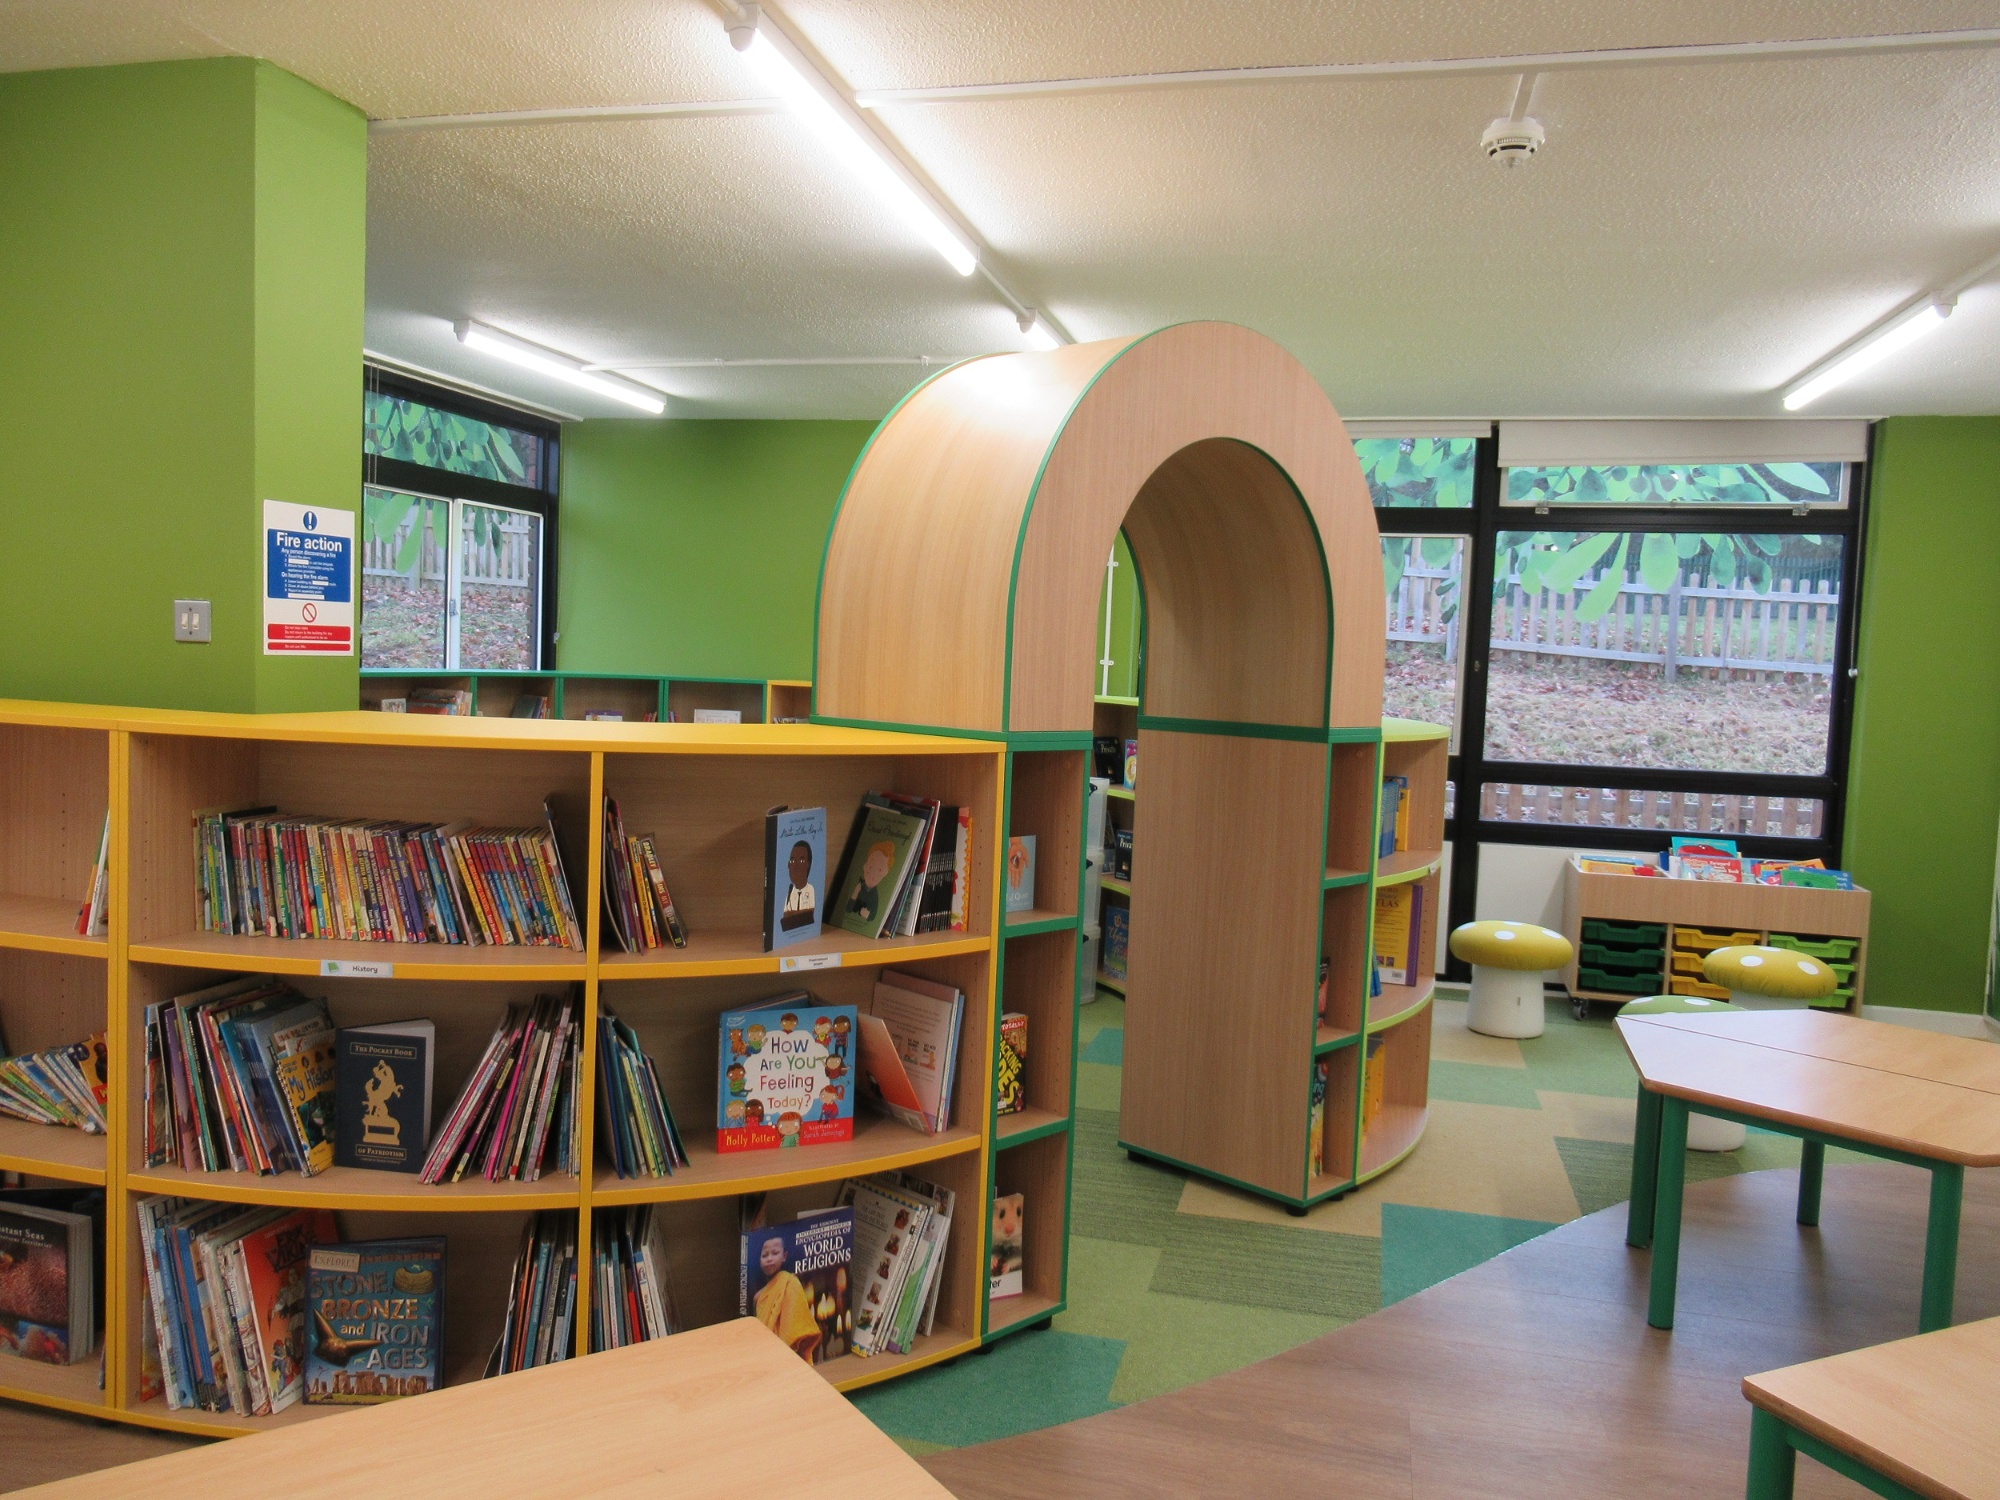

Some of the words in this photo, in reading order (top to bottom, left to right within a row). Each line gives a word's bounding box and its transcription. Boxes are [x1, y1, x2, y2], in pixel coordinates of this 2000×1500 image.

[276, 532, 300, 548] Fire
[304, 537, 342, 552] action
[642, 840, 656, 867] BRADLEY
[1002, 1021, 1024, 1030] TOTALLY
[771, 1037, 808, 1054] How
[760, 1059, 782, 1071] Are
[786, 1056, 816, 1070] You
[288, 1076, 306, 1100] My
[304, 1066, 336, 1090] Histor
[760, 1074, 814, 1092] Feeling
[768, 1094, 812, 1109] Today?
[726, 1134, 748, 1146] Molly
[752, 1132, 776, 1143] Potter
[25, 1229, 44, 1240] Seas
[804, 1236, 844, 1257] WORLD
[795, 1248, 851, 1274] RELIGIONS
[310, 1271, 394, 1298] STONE,
[322, 1298, 419, 1320] BRONZE
[340, 1324, 366, 1336] and
[371, 1322, 429, 1346] IRON
[366, 1349, 428, 1370] AGES
